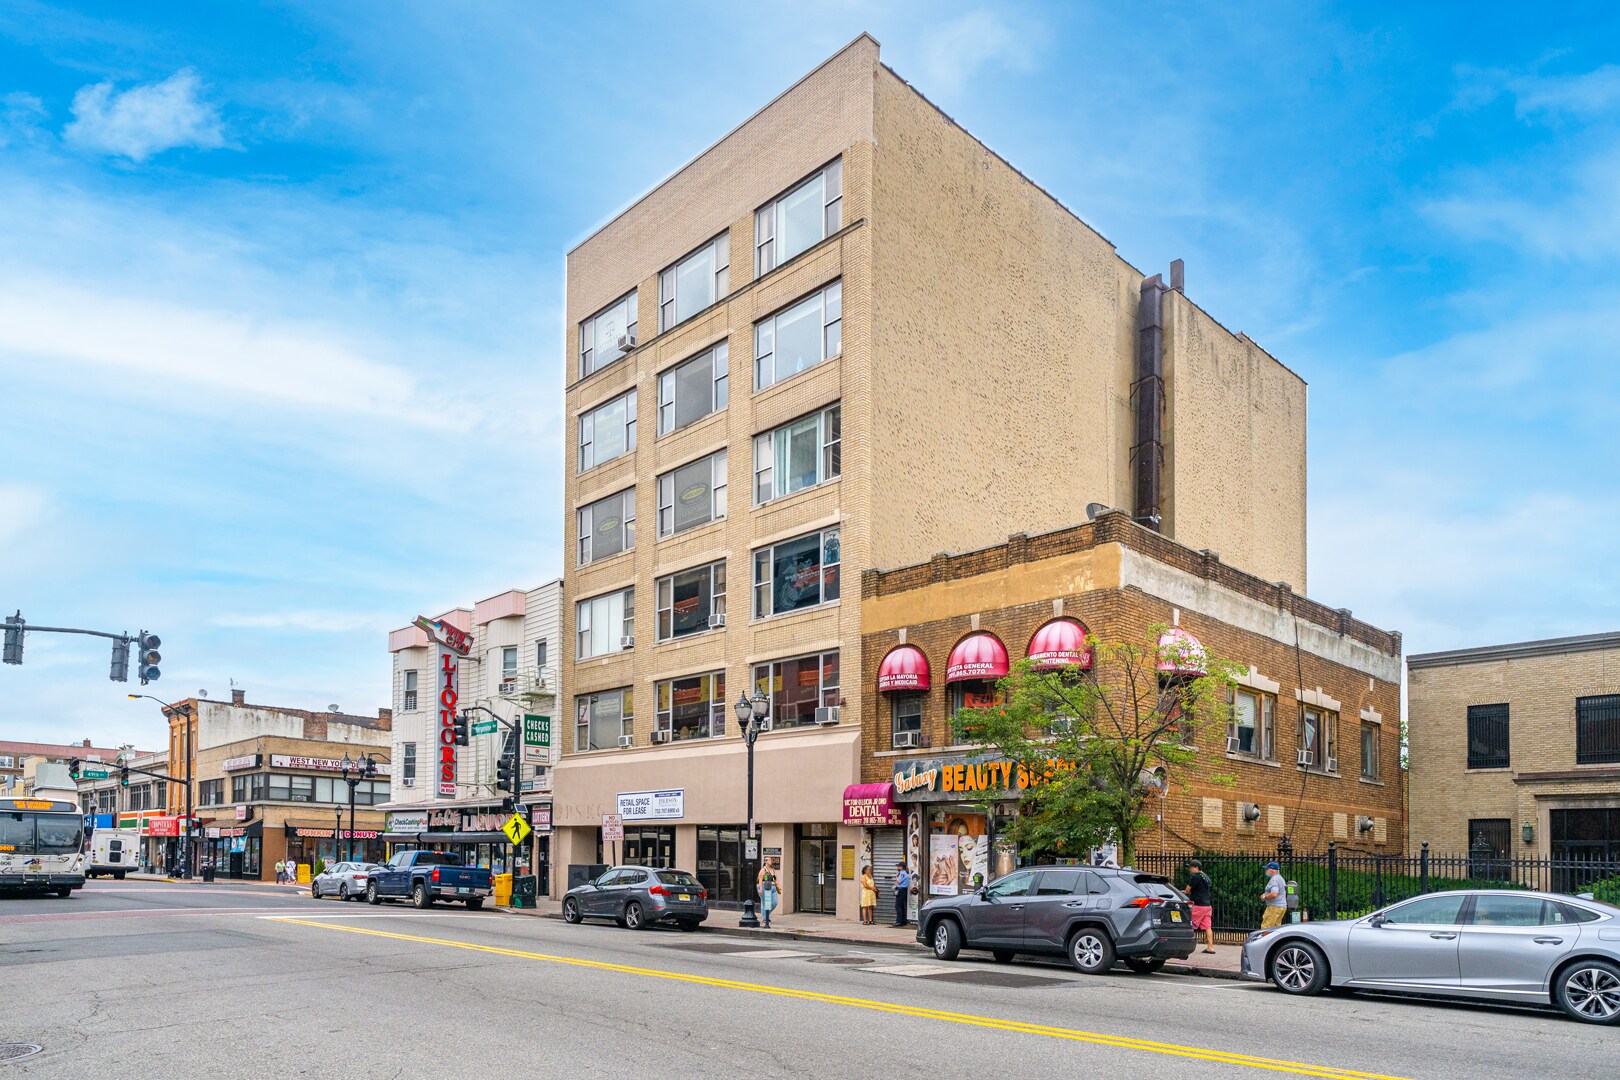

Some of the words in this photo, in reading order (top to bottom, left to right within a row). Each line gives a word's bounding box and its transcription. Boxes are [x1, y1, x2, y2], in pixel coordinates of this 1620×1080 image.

[440, 622, 467, 642] TWIN
[446, 636, 470, 653] CITY
[441, 654, 457, 782] LIQUORS
[526, 719, 549, 731] CHECKS
[526, 731, 549, 743] CASHED
[289, 756, 310, 764] WEST
[312, 758, 329, 767] NEW
[894, 766, 938, 794] Galaxy
[941, 761, 1013, 792] BEAUTY
[620, 799, 635, 807] RETAIL
[632, 806, 647, 814] LEASE
[849, 805, 882, 817] DENTAL
[533, 810, 551, 823] LOTTERY
[297, 829, 335, 838] DUNKIN'
[344, 830, 379, 839] DONUTS
